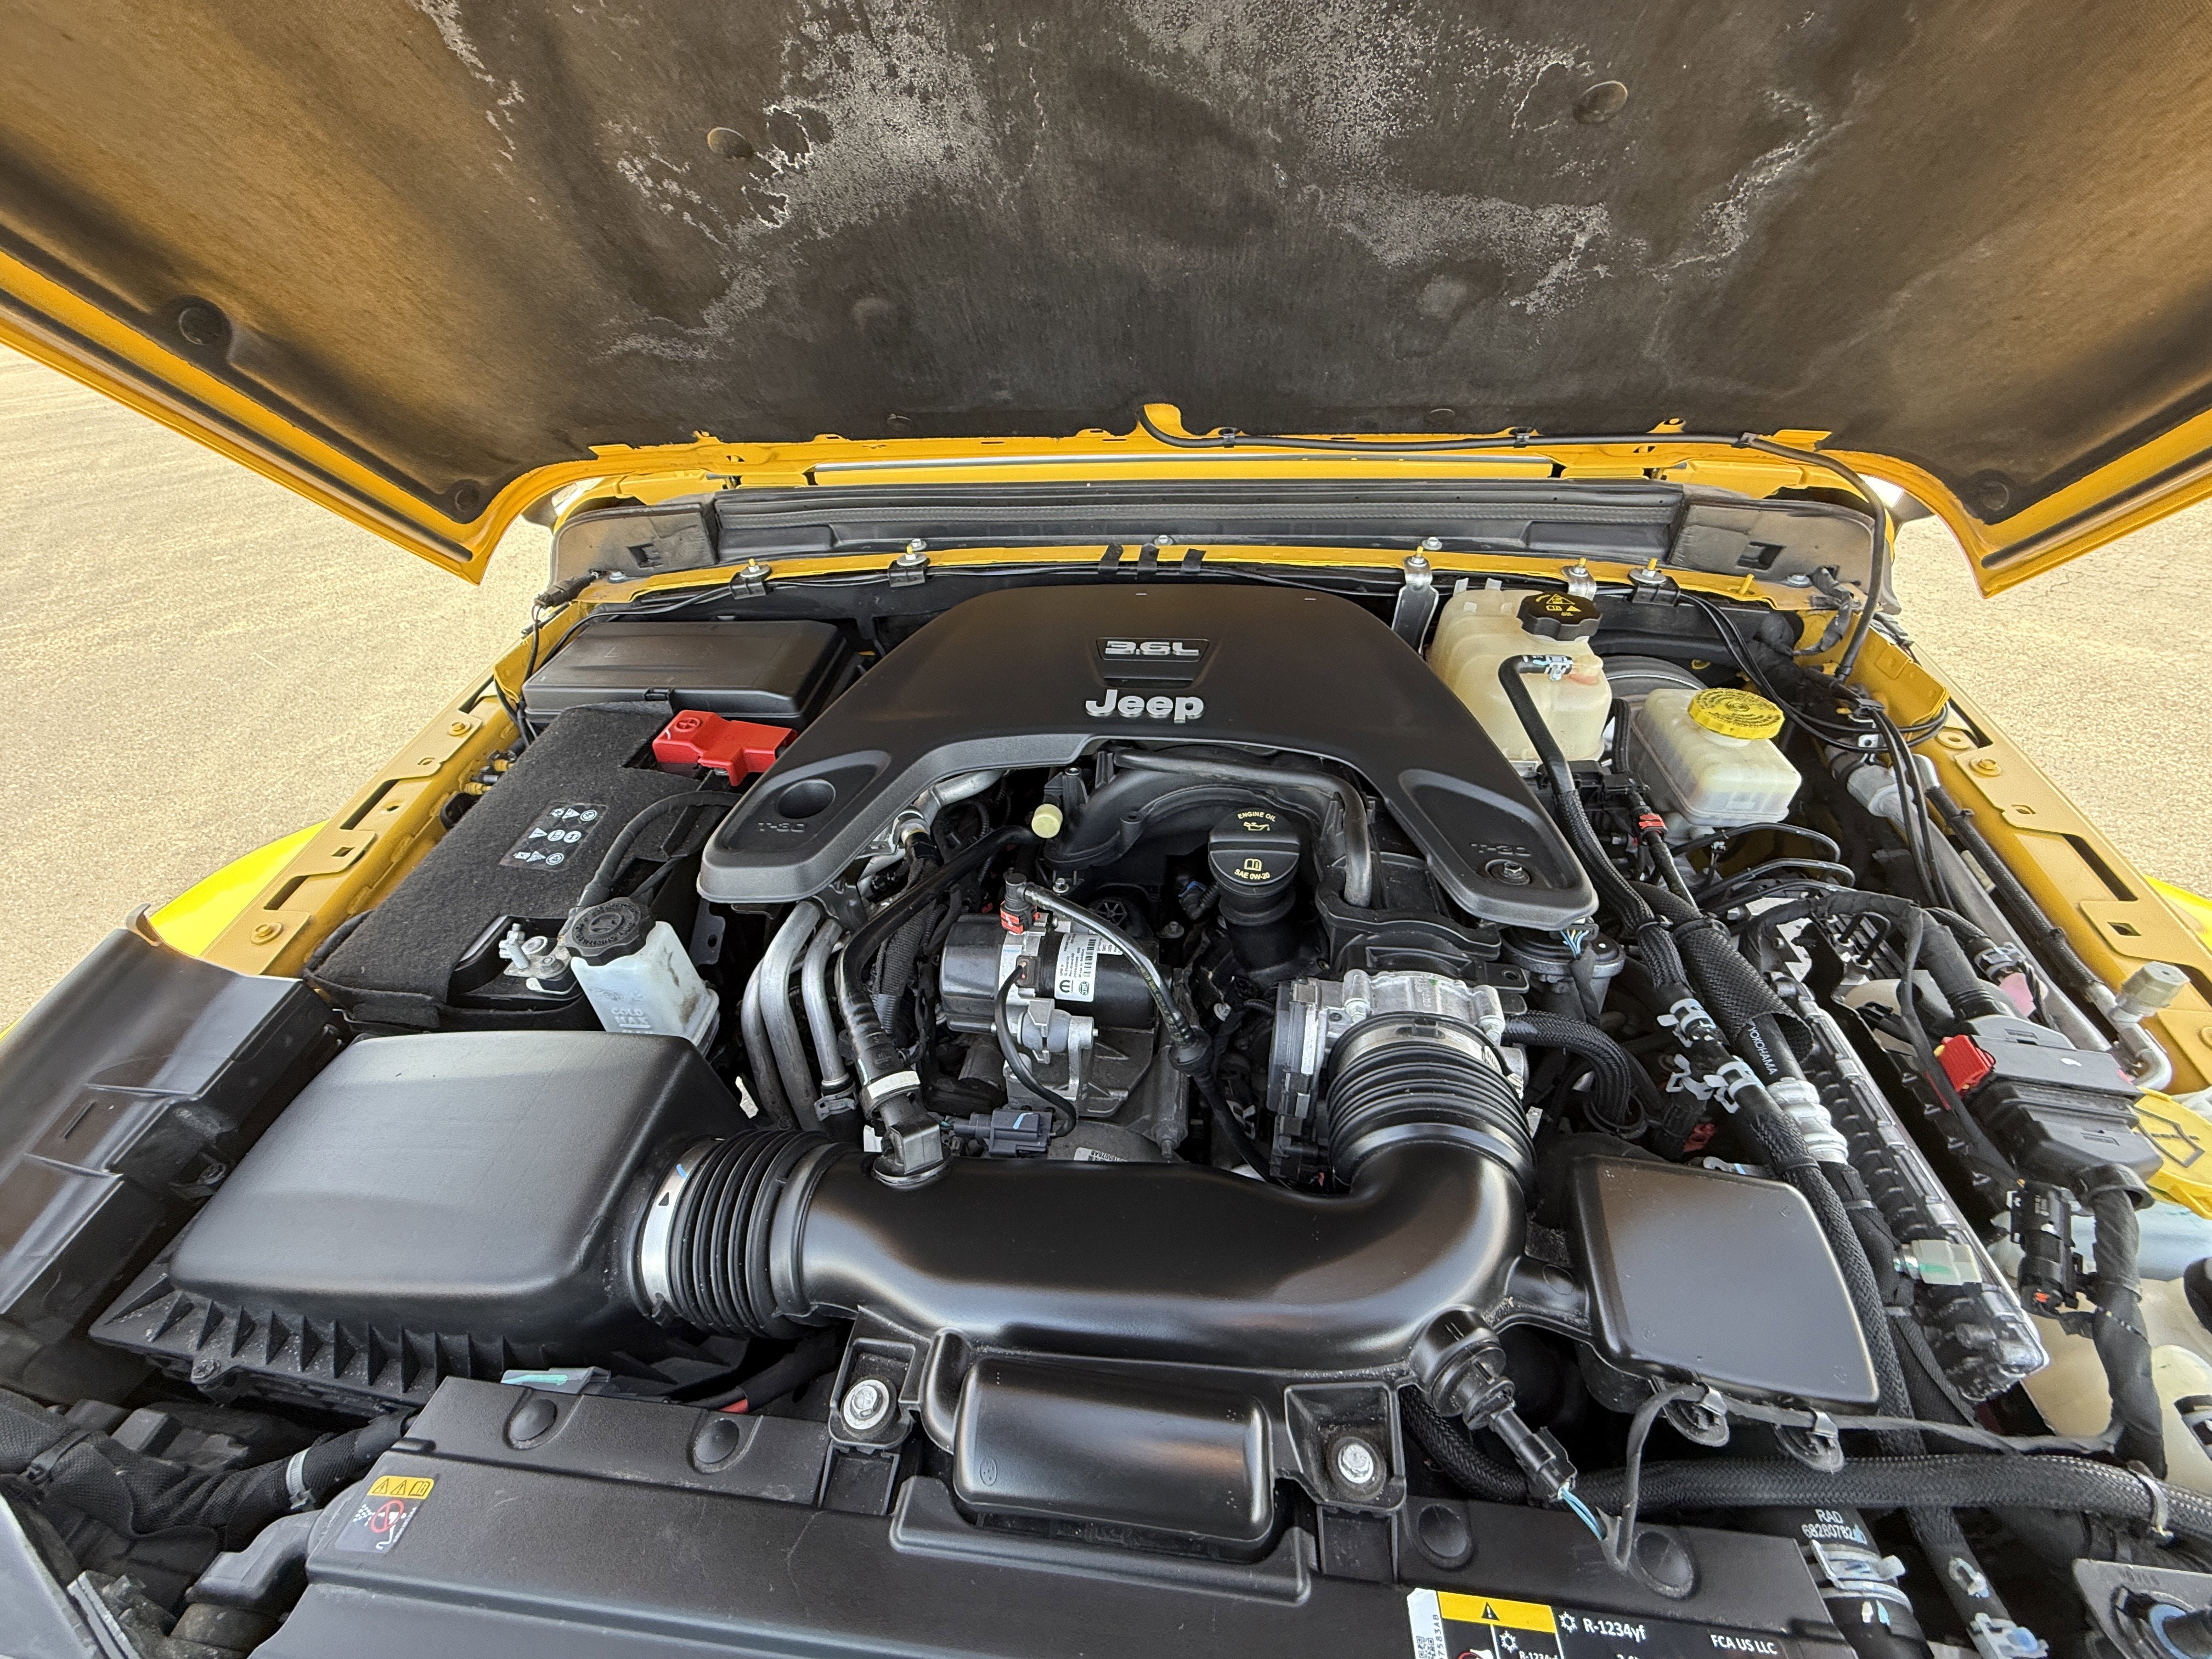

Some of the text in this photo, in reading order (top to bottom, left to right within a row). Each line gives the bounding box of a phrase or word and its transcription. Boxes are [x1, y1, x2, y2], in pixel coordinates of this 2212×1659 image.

[1105, 641, 1199, 656] 3.6L
[1085, 689, 1204, 724] Jeep
[1265, 813, 1277, 822] OIL
[1234, 868, 1271, 880] SAE 0W-20
[1748, 1026, 1778, 1075] YOKOHAMA
[1815, 1509, 1844, 1524] RAD
[1432, 1614, 1445, 1659] 7583AB
[1583, 1618, 1646, 1643] R-1234yf
[1710, 1634, 1778, 1655] FCA US LLC
